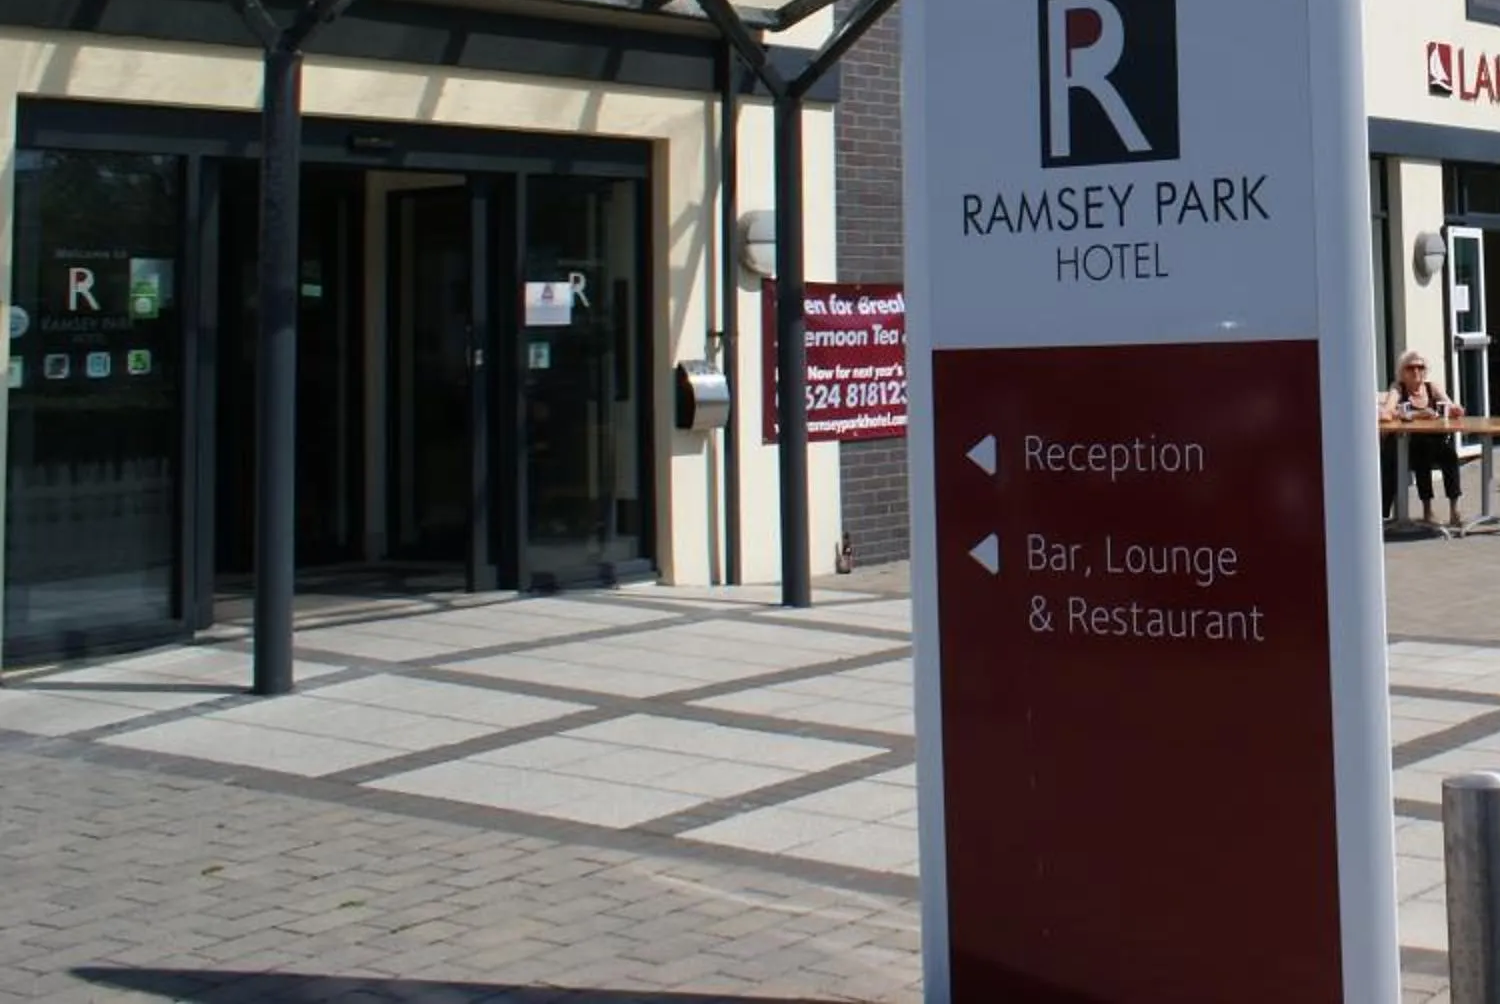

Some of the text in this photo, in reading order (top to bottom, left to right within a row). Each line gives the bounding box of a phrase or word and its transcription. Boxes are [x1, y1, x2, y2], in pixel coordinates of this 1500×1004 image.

[962, 174, 1271, 237] RAMSEY PARK
[1056, 242, 1169, 282] HOTEL
[68, 266, 102, 311] R
[829, 293, 853, 315] for
[804, 328, 868, 348] ernoon
[871, 323, 899, 346] Tea
[807, 365, 834, 381] Now
[835, 363, 851, 380] for
[1024, 435, 1204, 480] Reception
[1026, 533, 1239, 586] Bar, Lounge
[1028, 595, 1264, 643] & Restaurant
